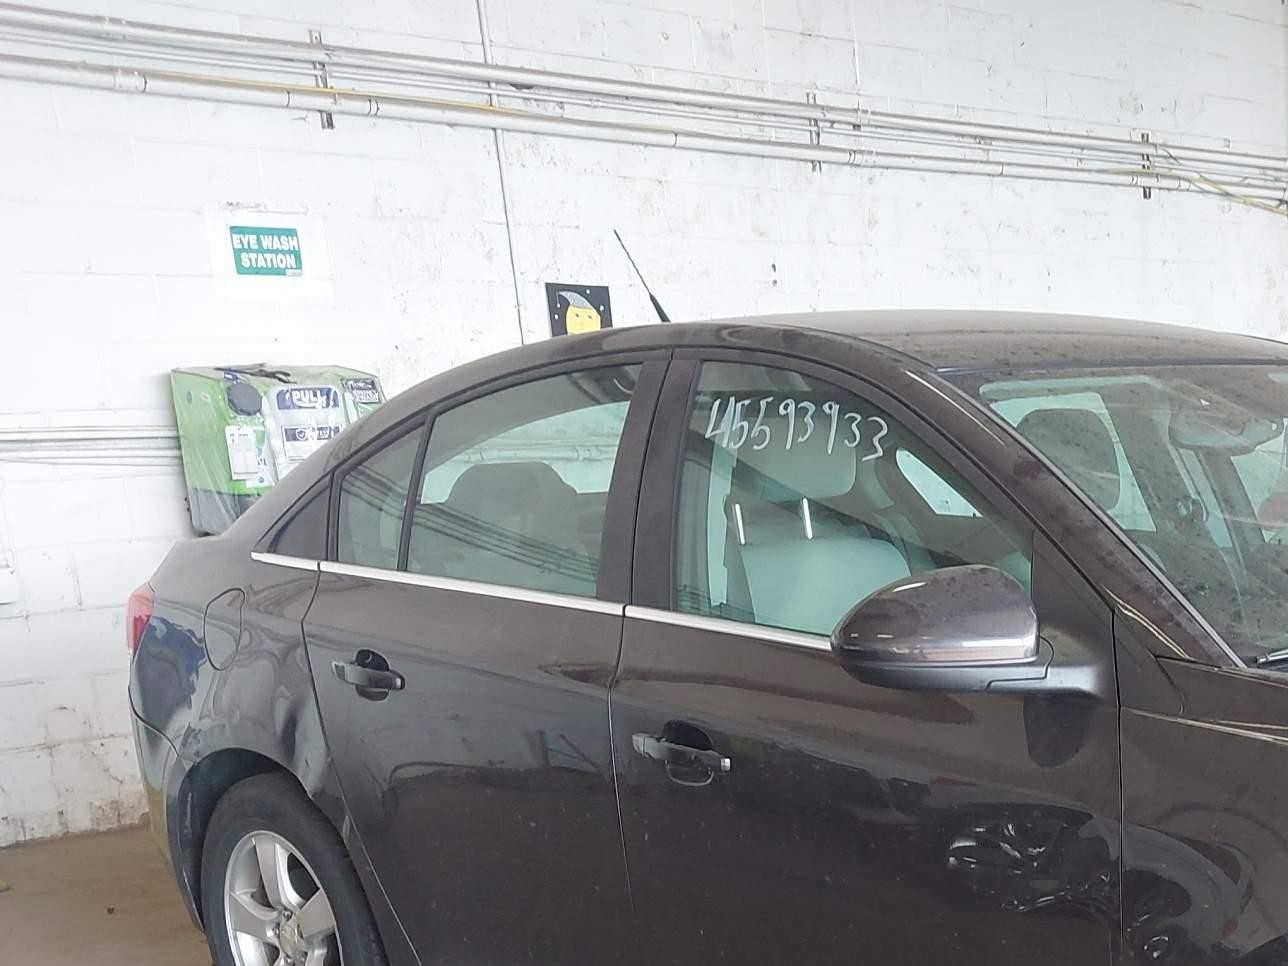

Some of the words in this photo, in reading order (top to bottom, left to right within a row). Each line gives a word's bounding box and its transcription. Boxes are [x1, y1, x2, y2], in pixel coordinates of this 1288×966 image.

[231, 233, 259, 249] EYE
[260, 234, 299, 251] WASH
[240, 252, 297, 269] STATION
[704, 396, 889, 462] 45593933
